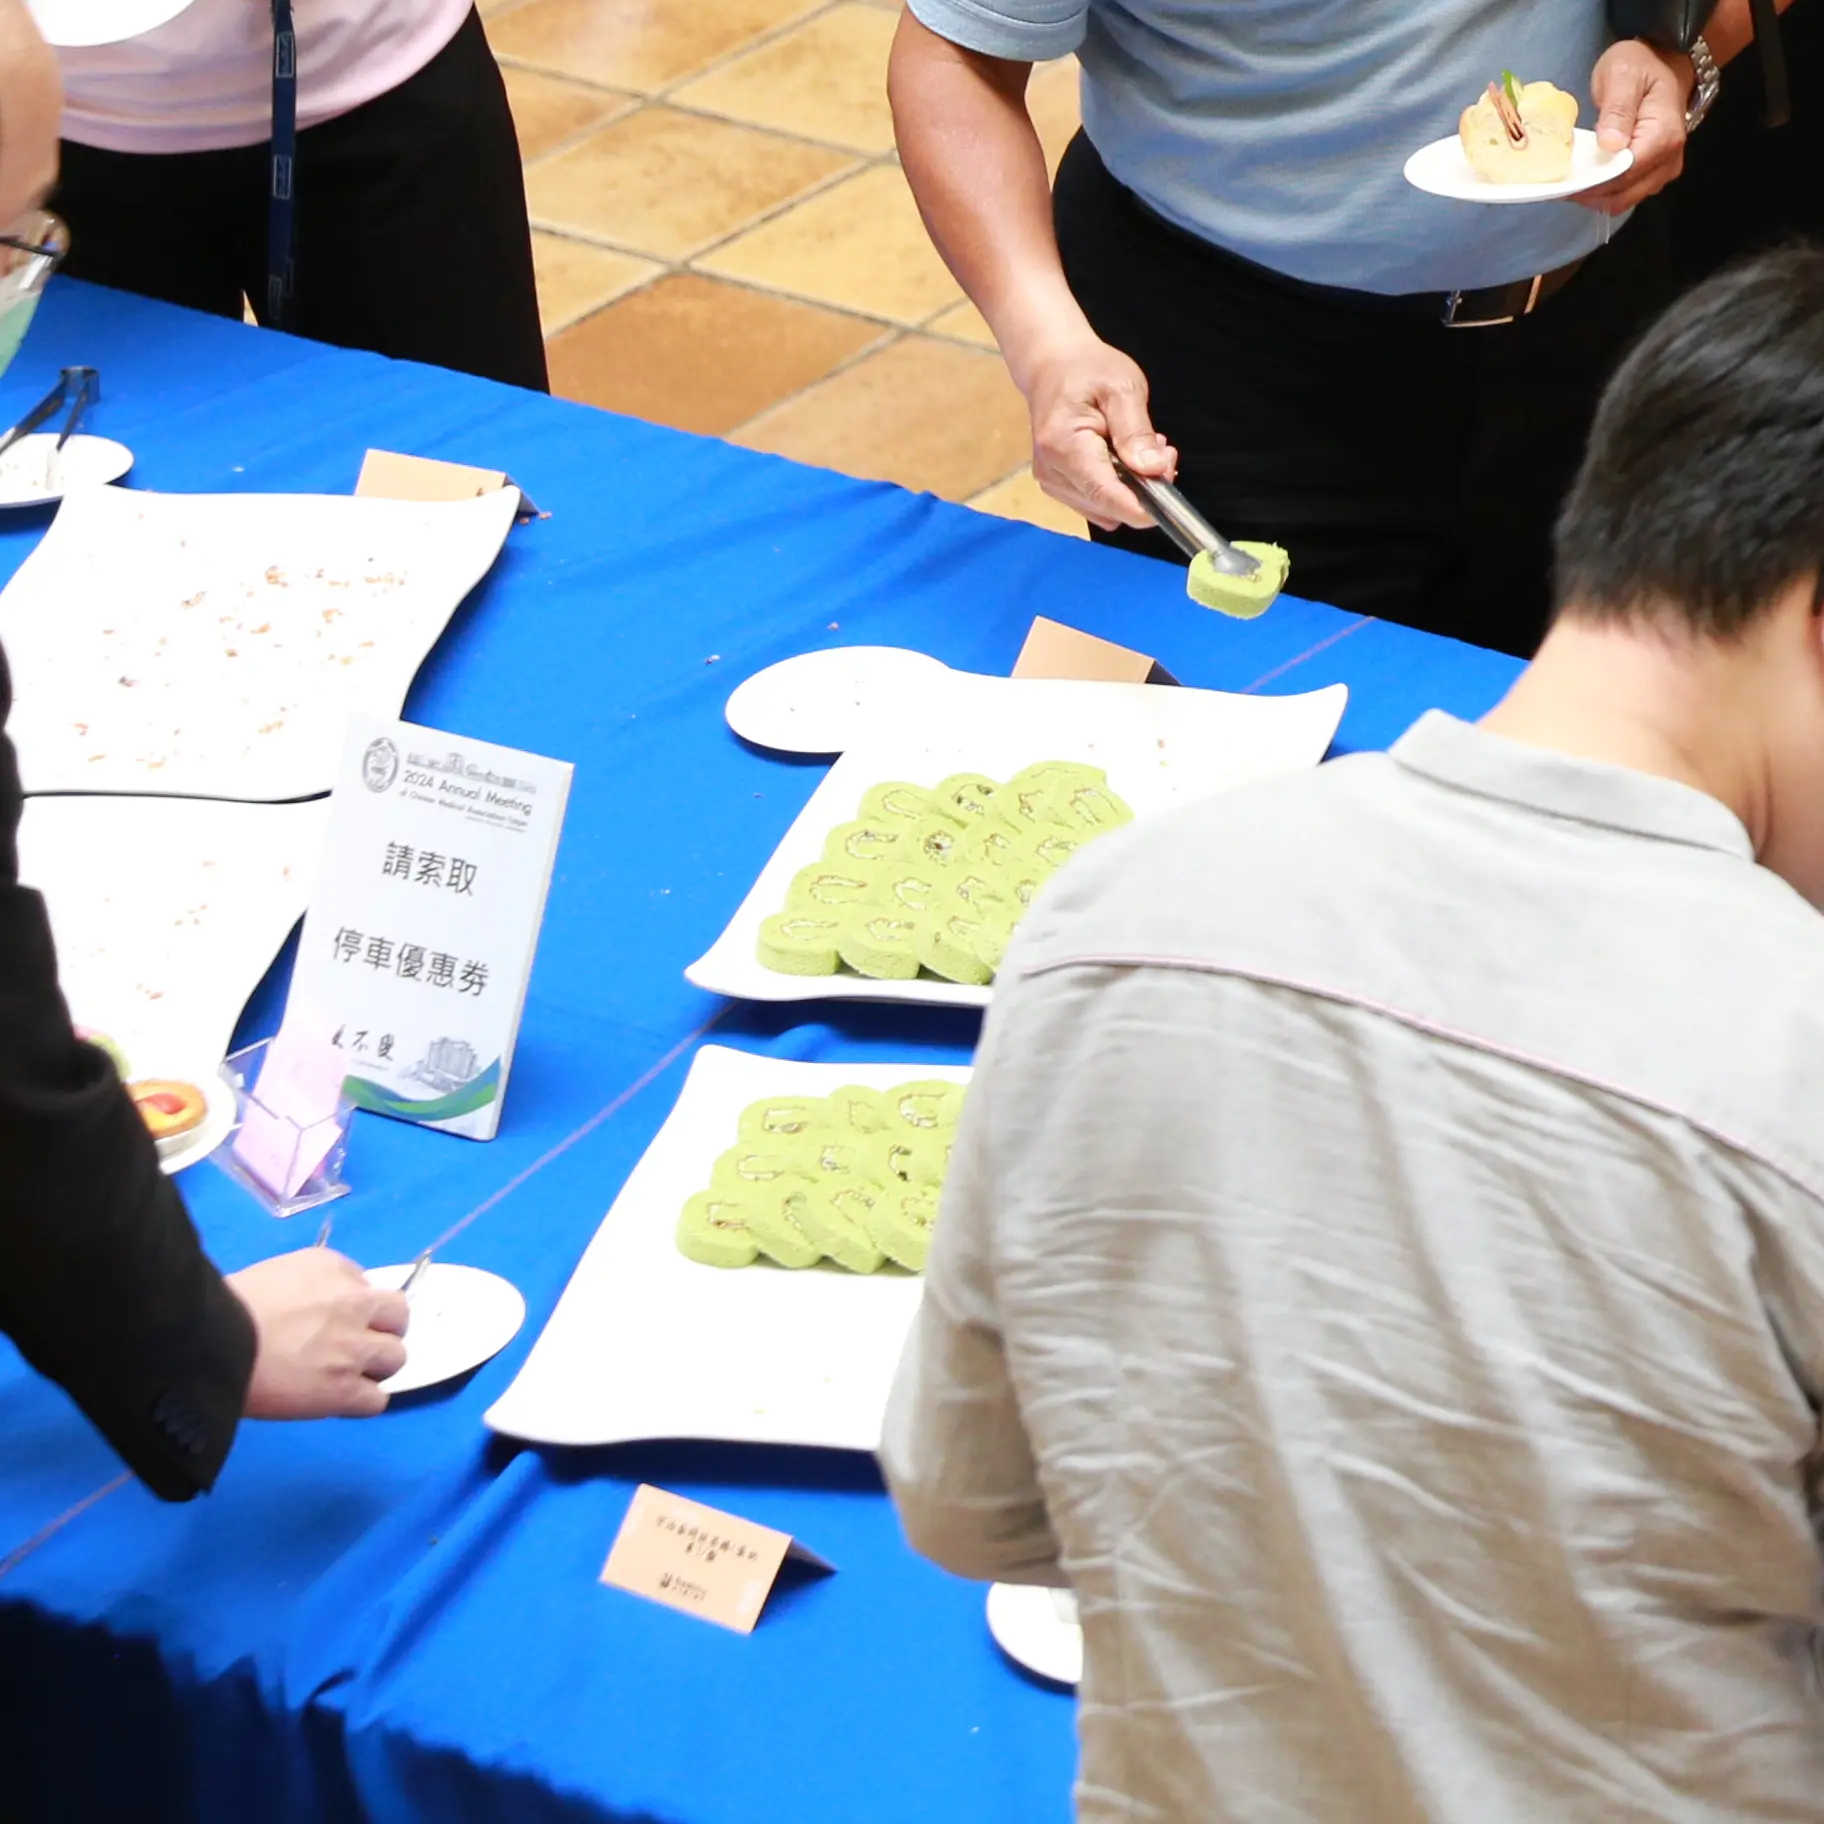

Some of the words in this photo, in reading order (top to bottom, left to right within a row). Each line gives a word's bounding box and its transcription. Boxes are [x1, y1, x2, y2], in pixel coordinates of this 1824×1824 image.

[439, 779, 481, 800] Annual
[486, 789, 533, 817] Meeting
[382, 840, 478, 897] 請索取
[333, 926, 490, 997] 停車優惠券
